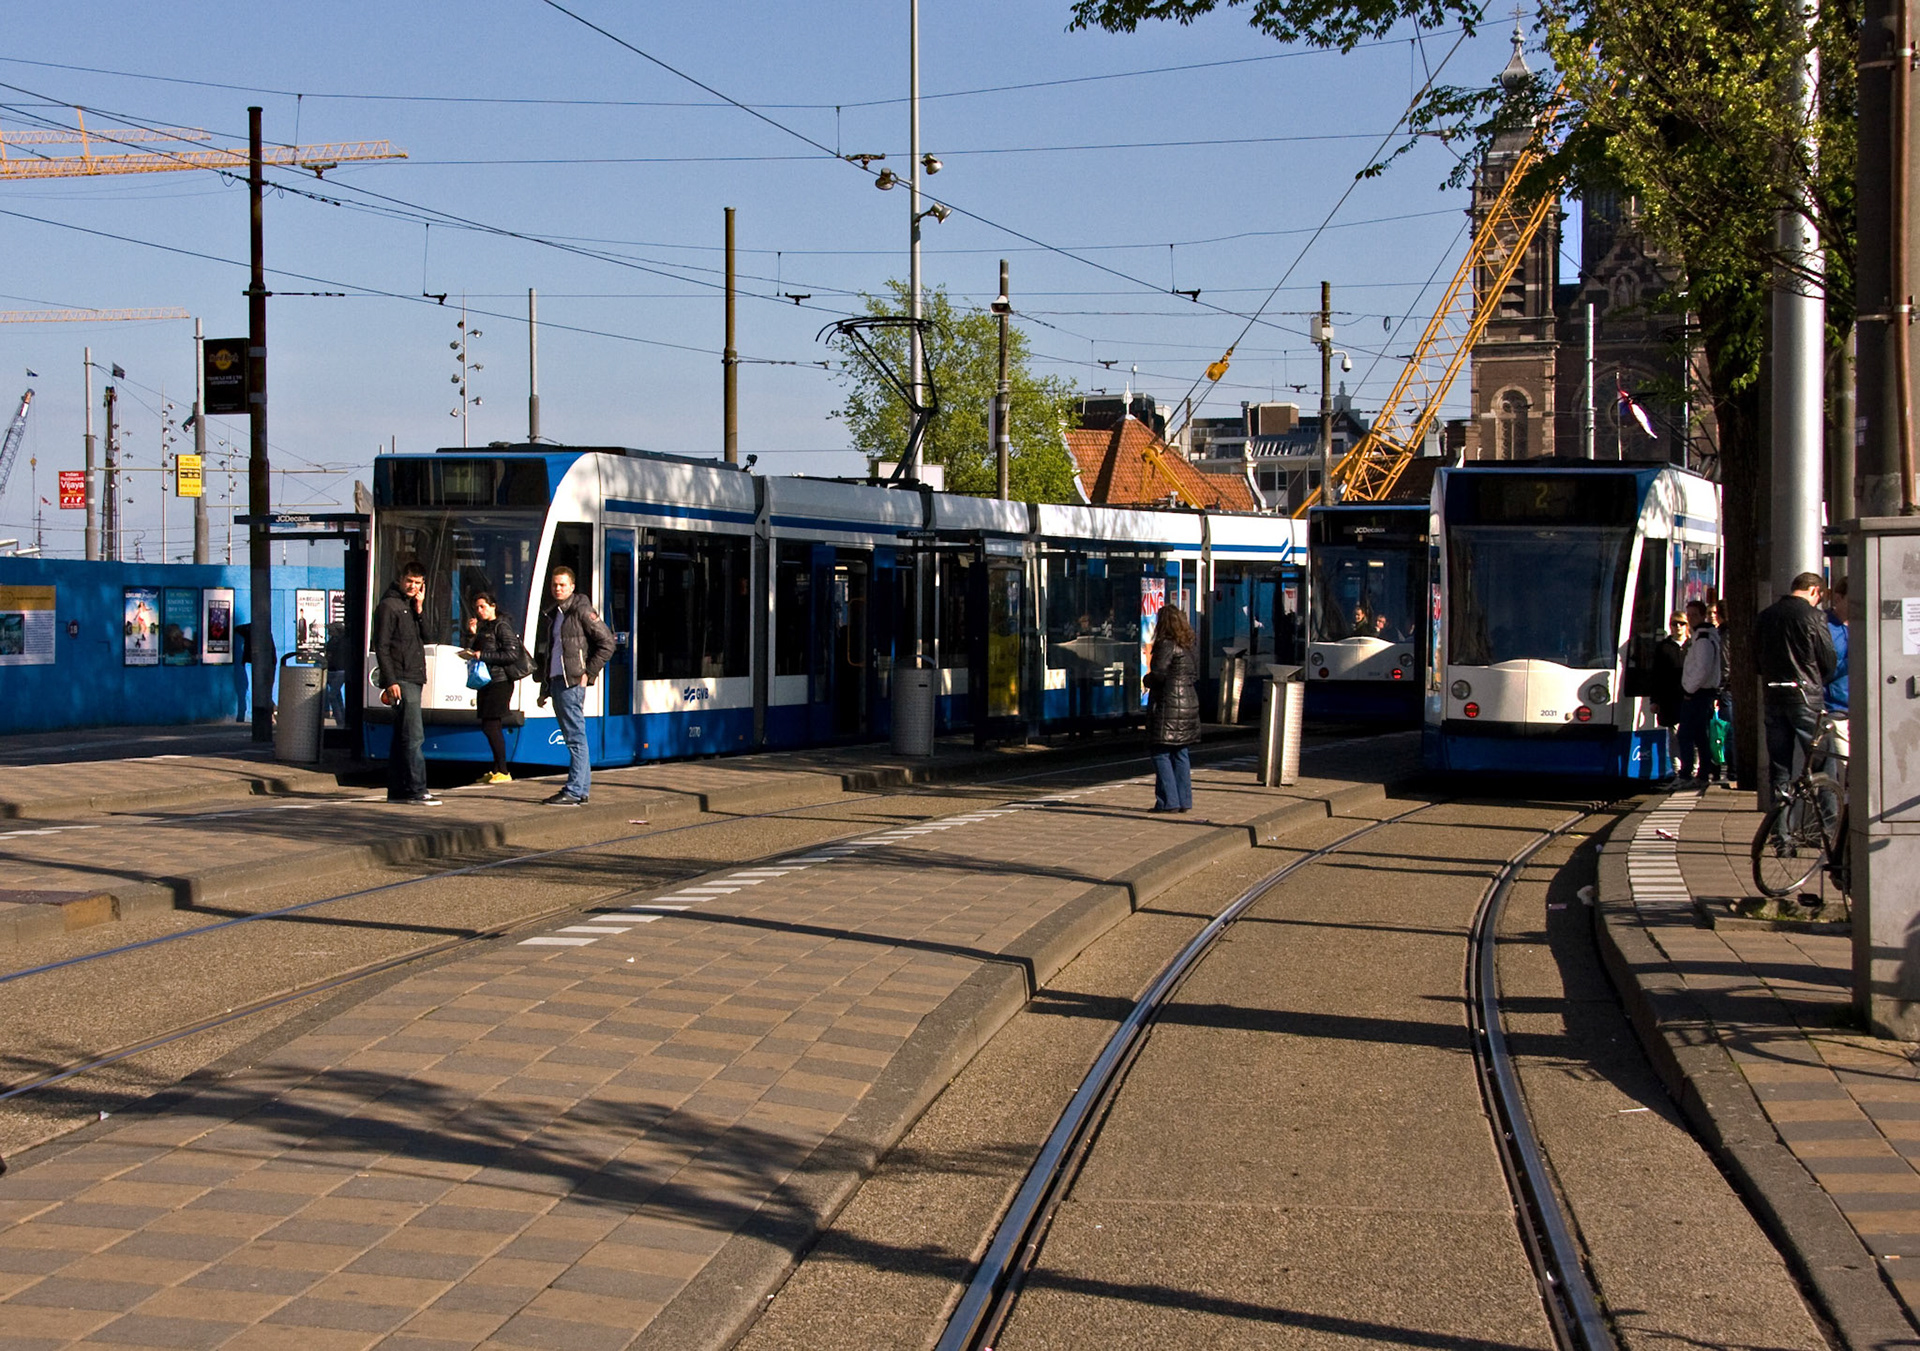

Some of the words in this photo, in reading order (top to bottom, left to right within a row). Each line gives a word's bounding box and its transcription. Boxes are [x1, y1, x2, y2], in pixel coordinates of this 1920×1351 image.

[60, 481, 84, 491] Vijaya
[1535, 482, 1548, 508] 2
[275, 515, 311, 523] JCDecaux
[1354, 526, 1385, 534] JCDecaux
[1141, 591, 1164, 616] KING
[444, 694, 463, 702] 2070
[696, 688, 709, 700] GVB
[1540, 709, 1557, 717] 2031
